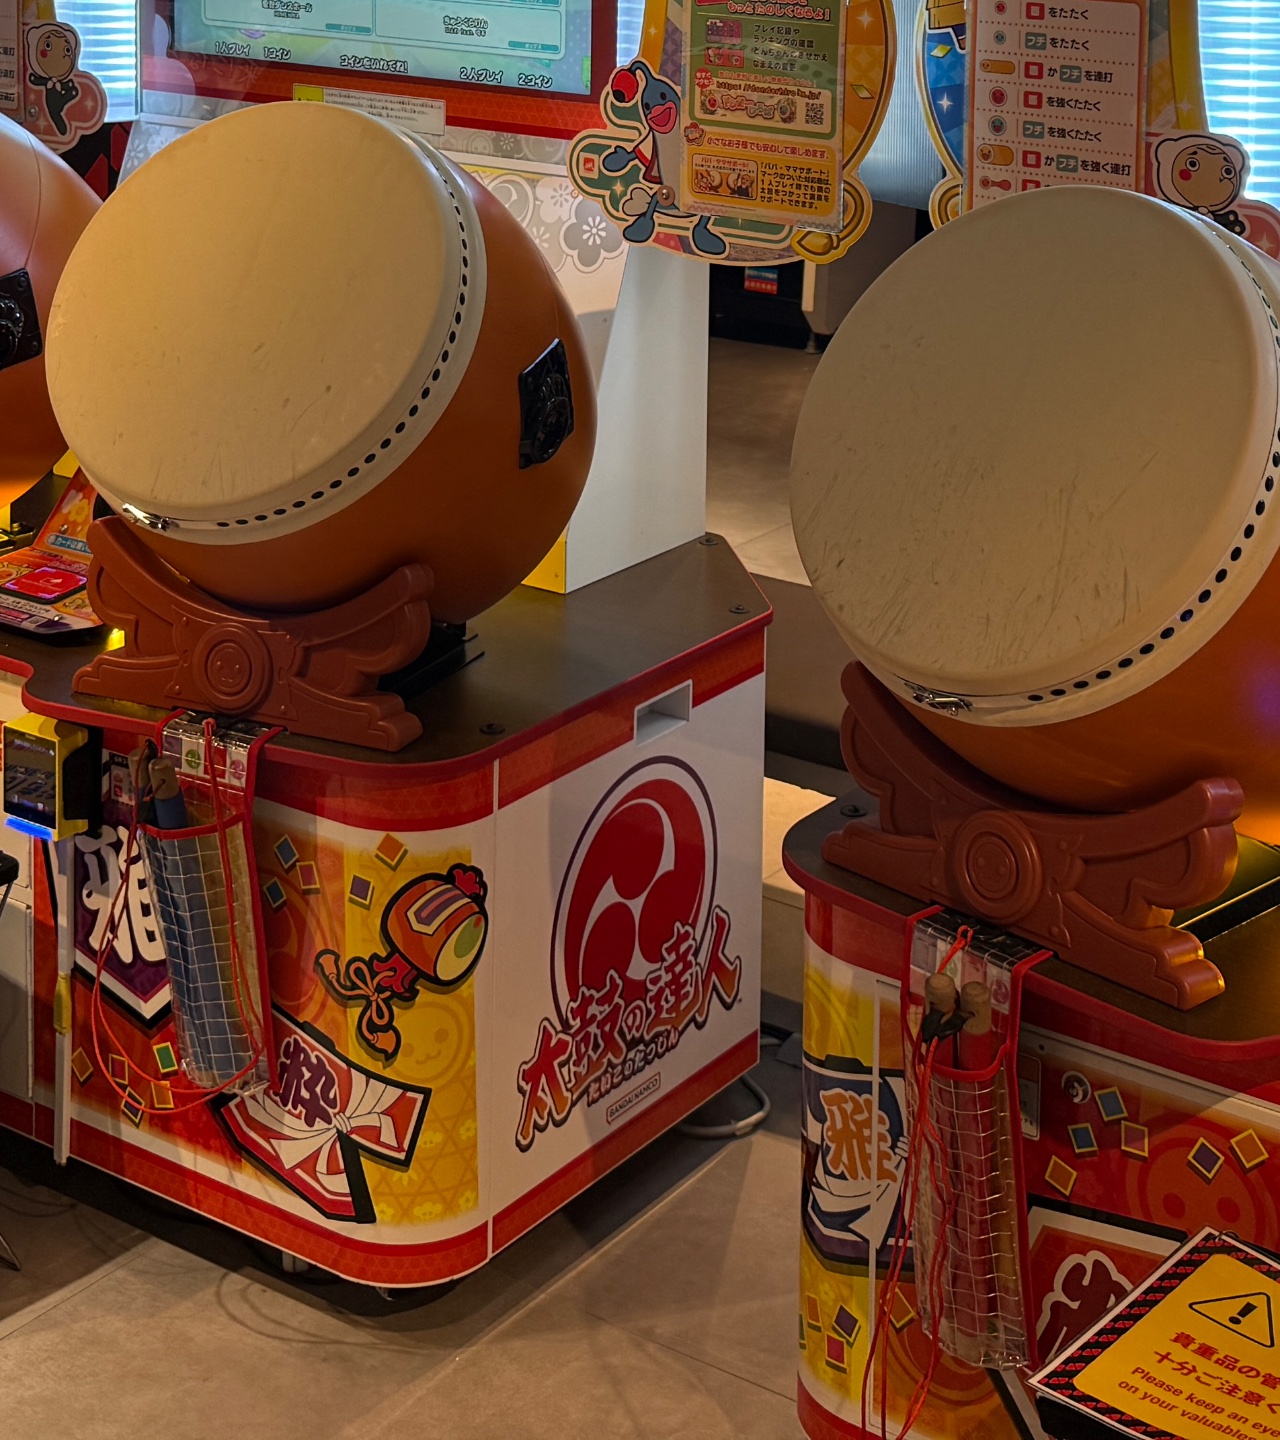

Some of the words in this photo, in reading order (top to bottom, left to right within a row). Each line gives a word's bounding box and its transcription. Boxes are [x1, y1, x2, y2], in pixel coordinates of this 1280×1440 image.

[1049, 8, 1089, 20] をたたく
[1027, 36, 1046, 45] フチ
[1050, 38, 1090, 50] をたたく
[215, 41, 251, 57] 1人プレイ
[263, 45, 291, 60] 1コイン
[340, 54, 408, 74] コインをいれてね!
[460, 66, 503, 83] 2人プレイ
[518, 71, 553, 88] 2コイン
[1084, 70, 1113, 83] を連打
[1046, 97, 1101, 111] を強くたたく
[1025, 125, 1043, 134] フチ
[1047, 127, 1101, 142] を強くたたく
[1080, 160, 1131, 176] を強く連打
[515, 905, 742, 1152] 太鼓の達人
[587, 1025, 680, 1107] たいこのたつじん
[609, 1092, 635, 1118] BANDAI
[634, 1076, 659, 1103] NAMCO
[1118, 1380, 1140, 1395] on
[1139, 1391, 1179, 1412] your
[1131, 1366, 1183, 1397] Please
[1185, 1392, 1225, 1416] keep
[1227, 1411, 1249, 1425] an
